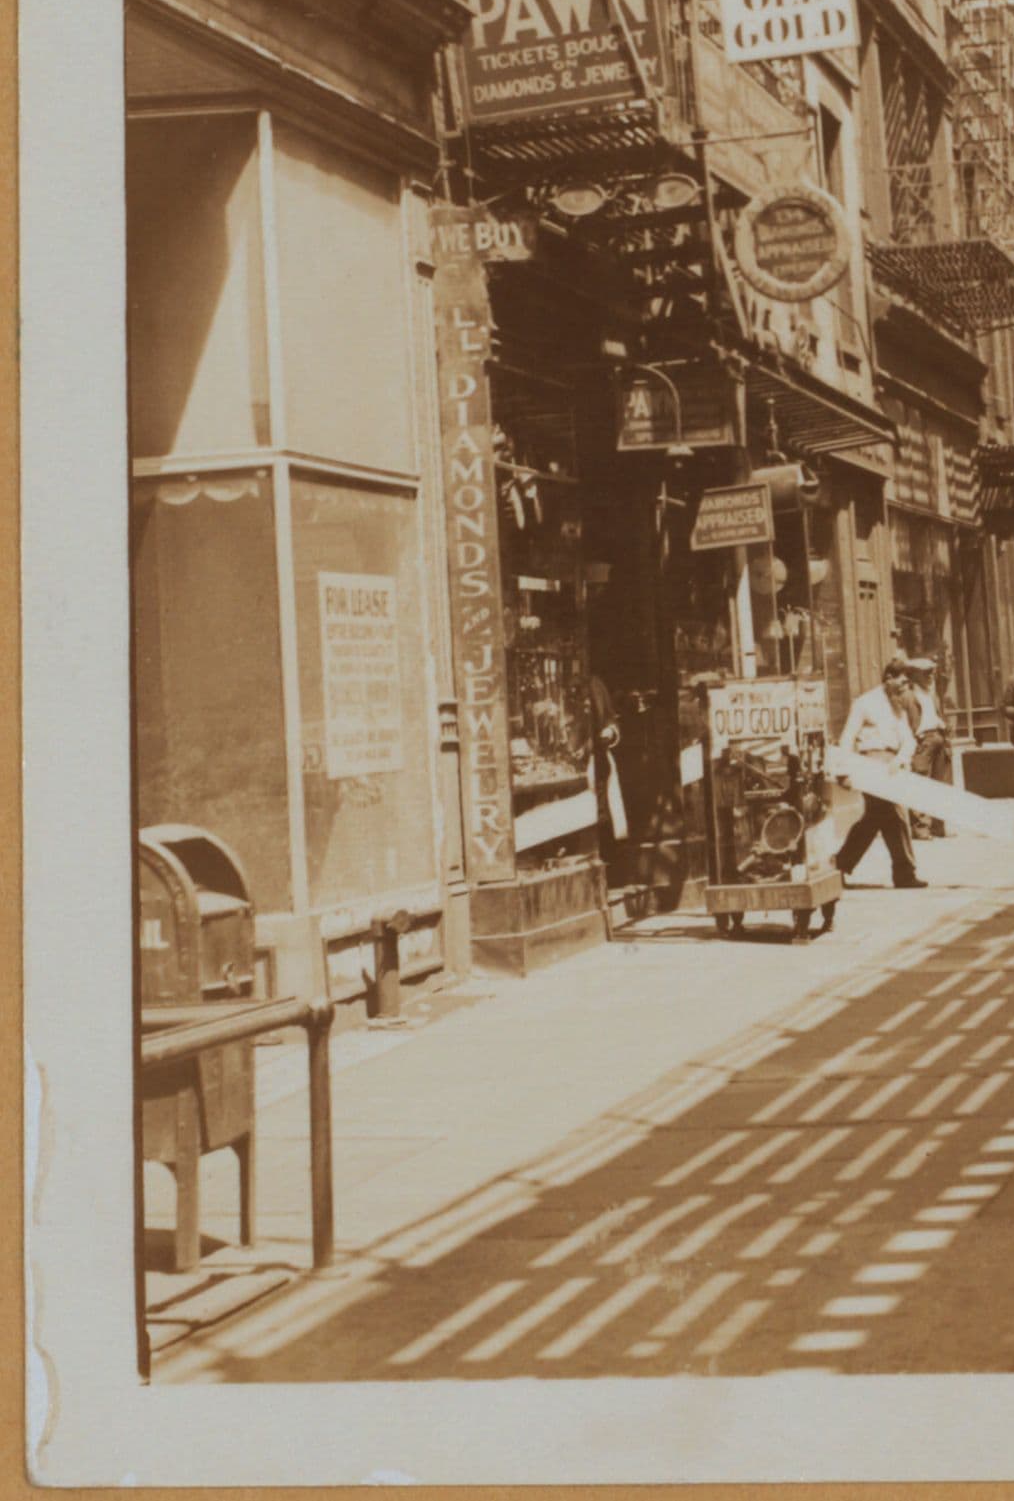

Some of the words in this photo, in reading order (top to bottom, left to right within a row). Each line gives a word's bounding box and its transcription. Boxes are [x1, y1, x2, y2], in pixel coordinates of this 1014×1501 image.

[734, 10, 847, 49] GOLD
[477, 43, 560, 72] TICKETS
[553, 59, 578, 71] ON
[473, 75, 557, 103] DIAMONDS
[560, 71, 576, 90] &
[474, 221, 524, 251] BUY
[449, 373, 489, 599] DIAMONDS
[714, 707, 745, 736] OLD
[749, 706, 791, 734] GOLD
[463, 643, 508, 866] JEWELRY
